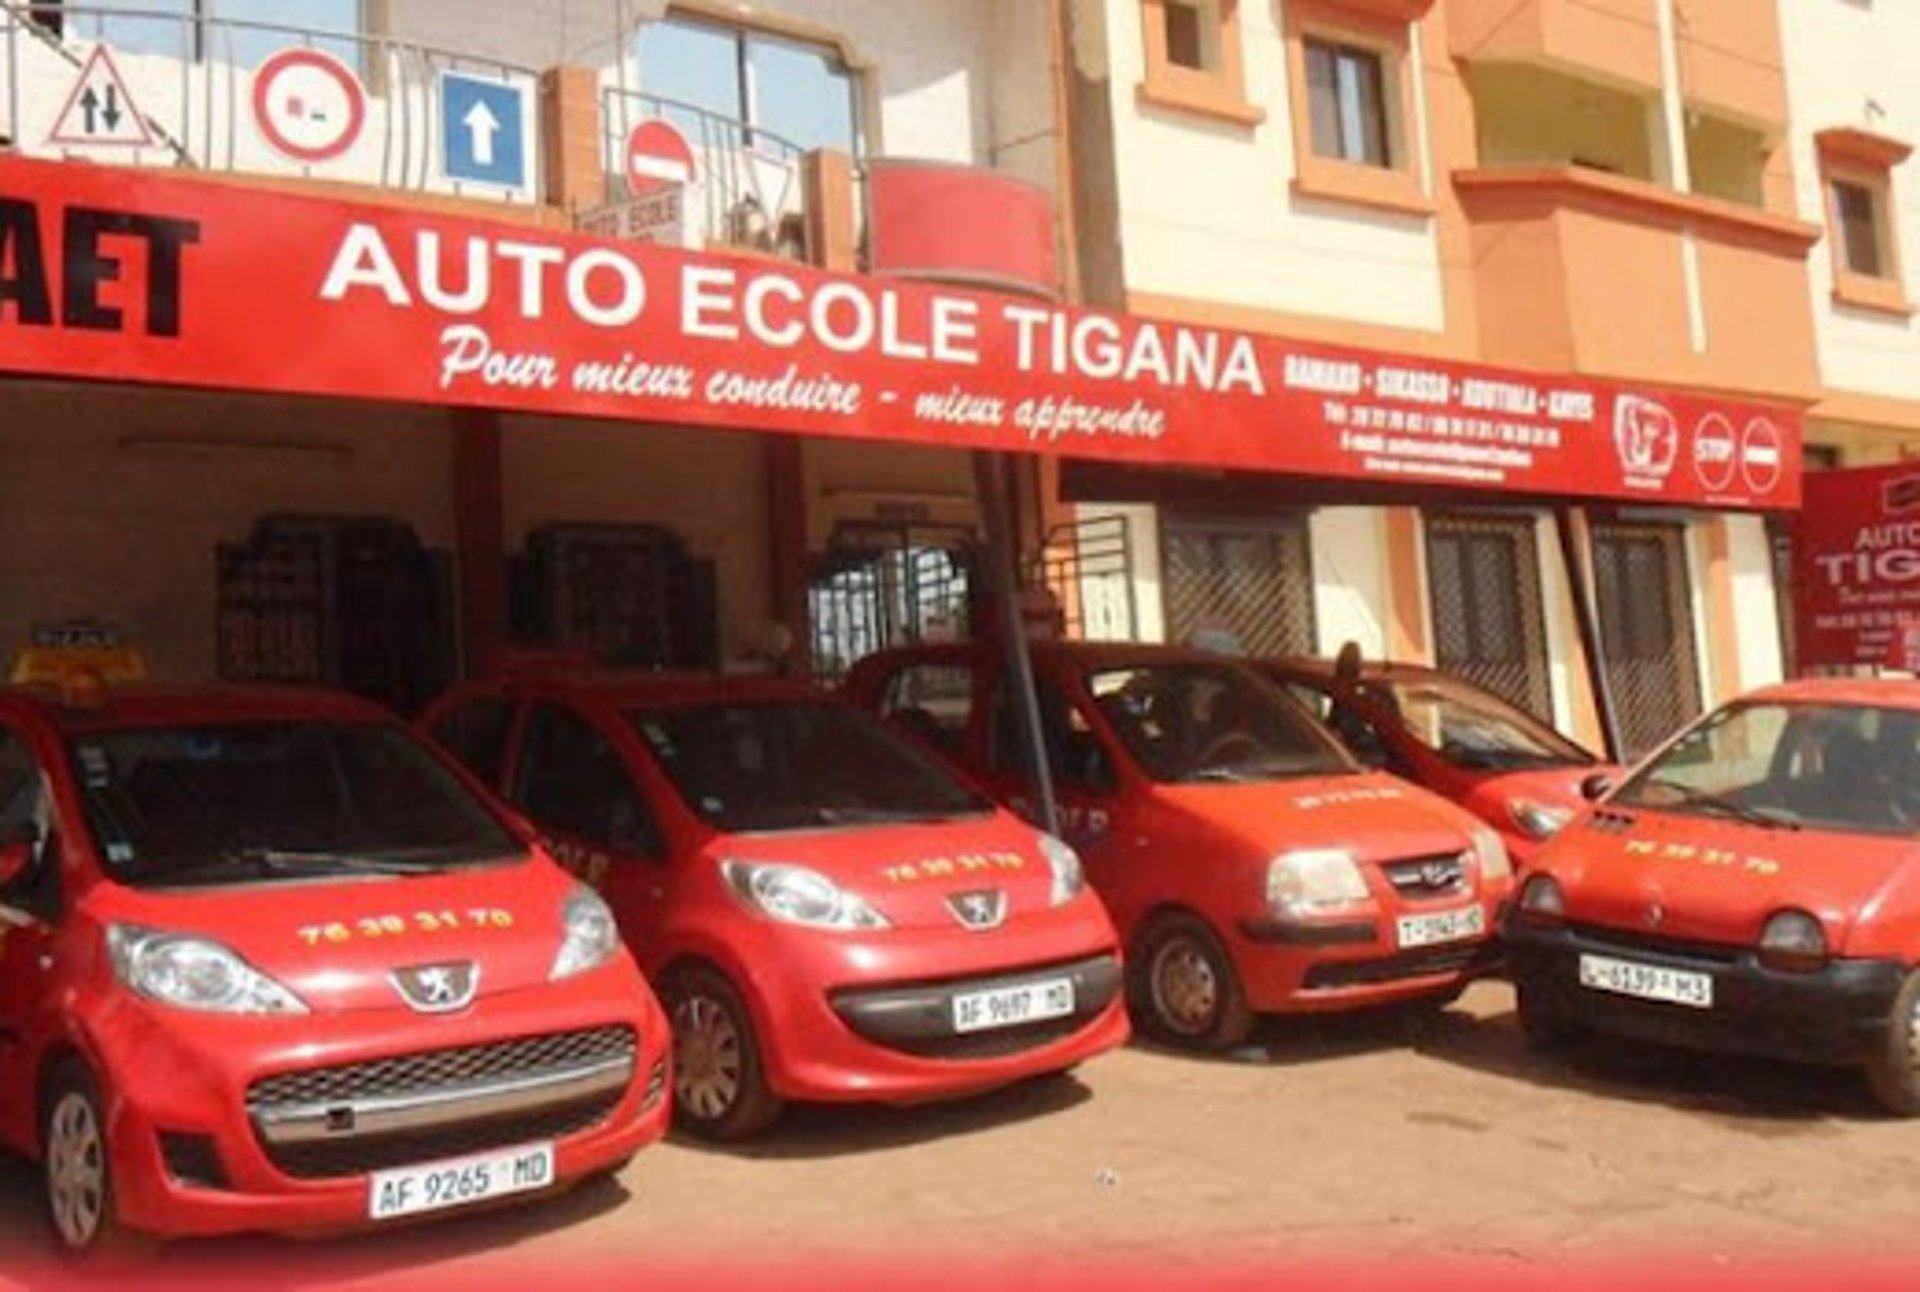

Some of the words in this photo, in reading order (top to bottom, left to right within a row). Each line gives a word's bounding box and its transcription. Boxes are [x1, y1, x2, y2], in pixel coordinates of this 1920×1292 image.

[0, 196, 201, 338] AET
[320, 222, 647, 327] AUTO
[681, 264, 979, 365] ECOLE
[1003, 304, 1265, 396] TIGANA
[440, 324, 558, 388] Pour
[572, 352, 693, 397] mieux
[705, 364, 861, 414] conduire
[915, 384, 1004, 425] mieux
[1013, 394, 1166, 440] apprendre
[467, 907, 513, 929] 70
[379, 1176, 416, 1212] AF
[424, 1165, 490, 1204] 9265
[513, 1151, 548, 1185] MD
